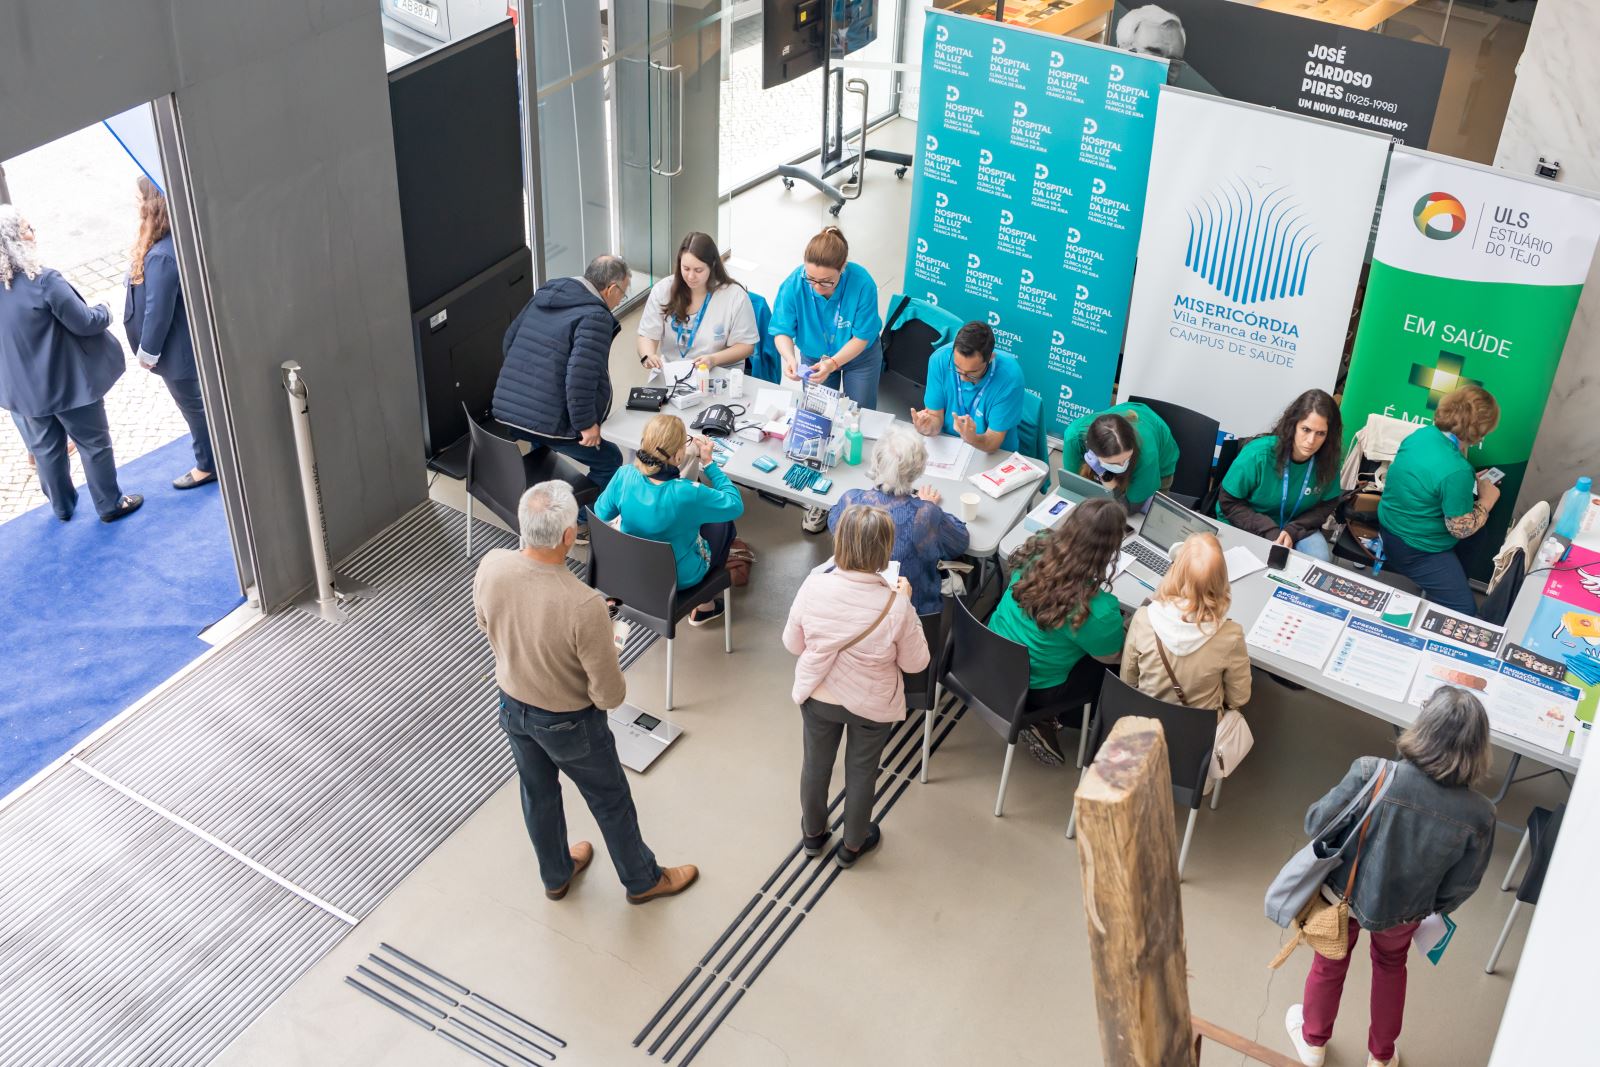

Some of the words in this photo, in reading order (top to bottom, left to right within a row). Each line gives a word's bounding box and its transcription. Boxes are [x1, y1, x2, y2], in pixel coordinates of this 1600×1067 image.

[934, 50, 946, 60] DA
[947, 53, 962, 64] LUZ
[935, 42, 973, 58] HOSPITAL
[1308, 44, 1347, 64] JOSÉ
[989, 63, 1002, 73] DA
[1002, 66, 1019, 77] LUZ
[990, 54, 1030, 71] HOSPITAL
[1048, 68, 1089, 84] HOSPITAL
[1305, 61, 1373, 88] CARDOSO
[1047, 76, 1060, 86] DA
[1060, 79, 1077, 90] LUZ
[1107, 81, 1150, 98] HOSPITAL
[1302, 78, 1344, 100] PIRES
[1106, 90, 1119, 100] DA
[1120, 93, 1138, 104] LUZ
[944, 109, 956, 118] DA
[957, 112, 973, 123] LUZ
[945, 101, 984, 117] HOSPITAL
[1298, 98, 1312, 109] UM
[1313, 102, 1337, 115] NOVO
[1338, 108, 1408, 131] NEO-REALISMO?
[1011, 126, 1023, 136] DA
[1024, 129, 1040, 140] LUZ
[1012, 118, 1051, 134] HOSPITAL
[1080, 142, 1093, 152] DA
[1093, 146, 1110, 157] LUZ
[1081, 134, 1122, 151] HOSPITAL
[924, 158, 935, 168] DA
[936, 162, 951, 172] LUZ
[925, 151, 961, 167] HOSPITAL
[977, 172, 989, 182] DA
[990, 175, 1006, 186] LUZ
[978, 164, 1016, 181] HOSPITAL
[1032, 187, 1044, 197] DA
[1045, 190, 1062, 201] LUZ
[1033, 179, 1073, 196] HOSPITAL
[1089, 202, 1101, 212] DA
[1102, 205, 1119, 216] LUZ
[1090, 194, 1130, 211] HOSPITAL
[934, 207, 972, 223] HOSPITAL
[934, 214, 945, 224] DA
[946, 217, 961, 228] LUZ
[1494, 206, 1530, 229] ULS
[998, 232, 1010, 242] DA
[1010, 236, 1026, 247] LUZ
[999, 225, 1037, 242] HOSPITAL
[1489, 226, 1553, 255] ESTUÁRIO
[1064, 250, 1077, 260] DA
[1077, 254, 1094, 265] LUZ
[1065, 243, 1105, 260] HOSPITAL
[1485, 241, 1506, 257] DO
[1509, 246, 1541, 267] TEJO
[915, 260, 926, 269] DA
[926, 263, 941, 274] LUZ
[916, 253, 950, 269] HOSPITAL
[965, 275, 977, 284] DA
[977, 278, 993, 289] LUZ
[966, 268, 1003, 285] HOSPITAL
[1018, 291, 1030, 300] DA
[1030, 294, 1046, 305] LUZ
[1019, 283, 1057, 301] HOSPITAL
[1072, 307, 1085, 317] DA
[1085, 311, 1102, 322] LUZ
[1074, 300, 1113, 317] HOSPITAL
[1174, 295, 1299, 338] MISERICÓRDIA
[992, 327, 1023, 342] OSPITAL
[1173, 309, 1197, 325] Vila
[1201, 317, 1246, 338] Franca
[1250, 330, 1267, 343] de
[1270, 334, 1297, 351] Xira
[1403, 313, 1437, 337] EM
[1441, 324, 1513, 359] SAÚDE
[997, 336, 1012, 346] LUZ
[1169, 327, 1225, 350] CAMPUS
[1228, 341, 1246, 356] DE
[1249, 347, 1295, 369] SAÚDE
[1048, 351, 1060, 361] DA
[1061, 355, 1077, 366] LUZ
[1050, 344, 1087, 362] HOSPITAL
[1057, 405, 1068, 415] DA
[1352, 620, 1383, 634] APRENDA
